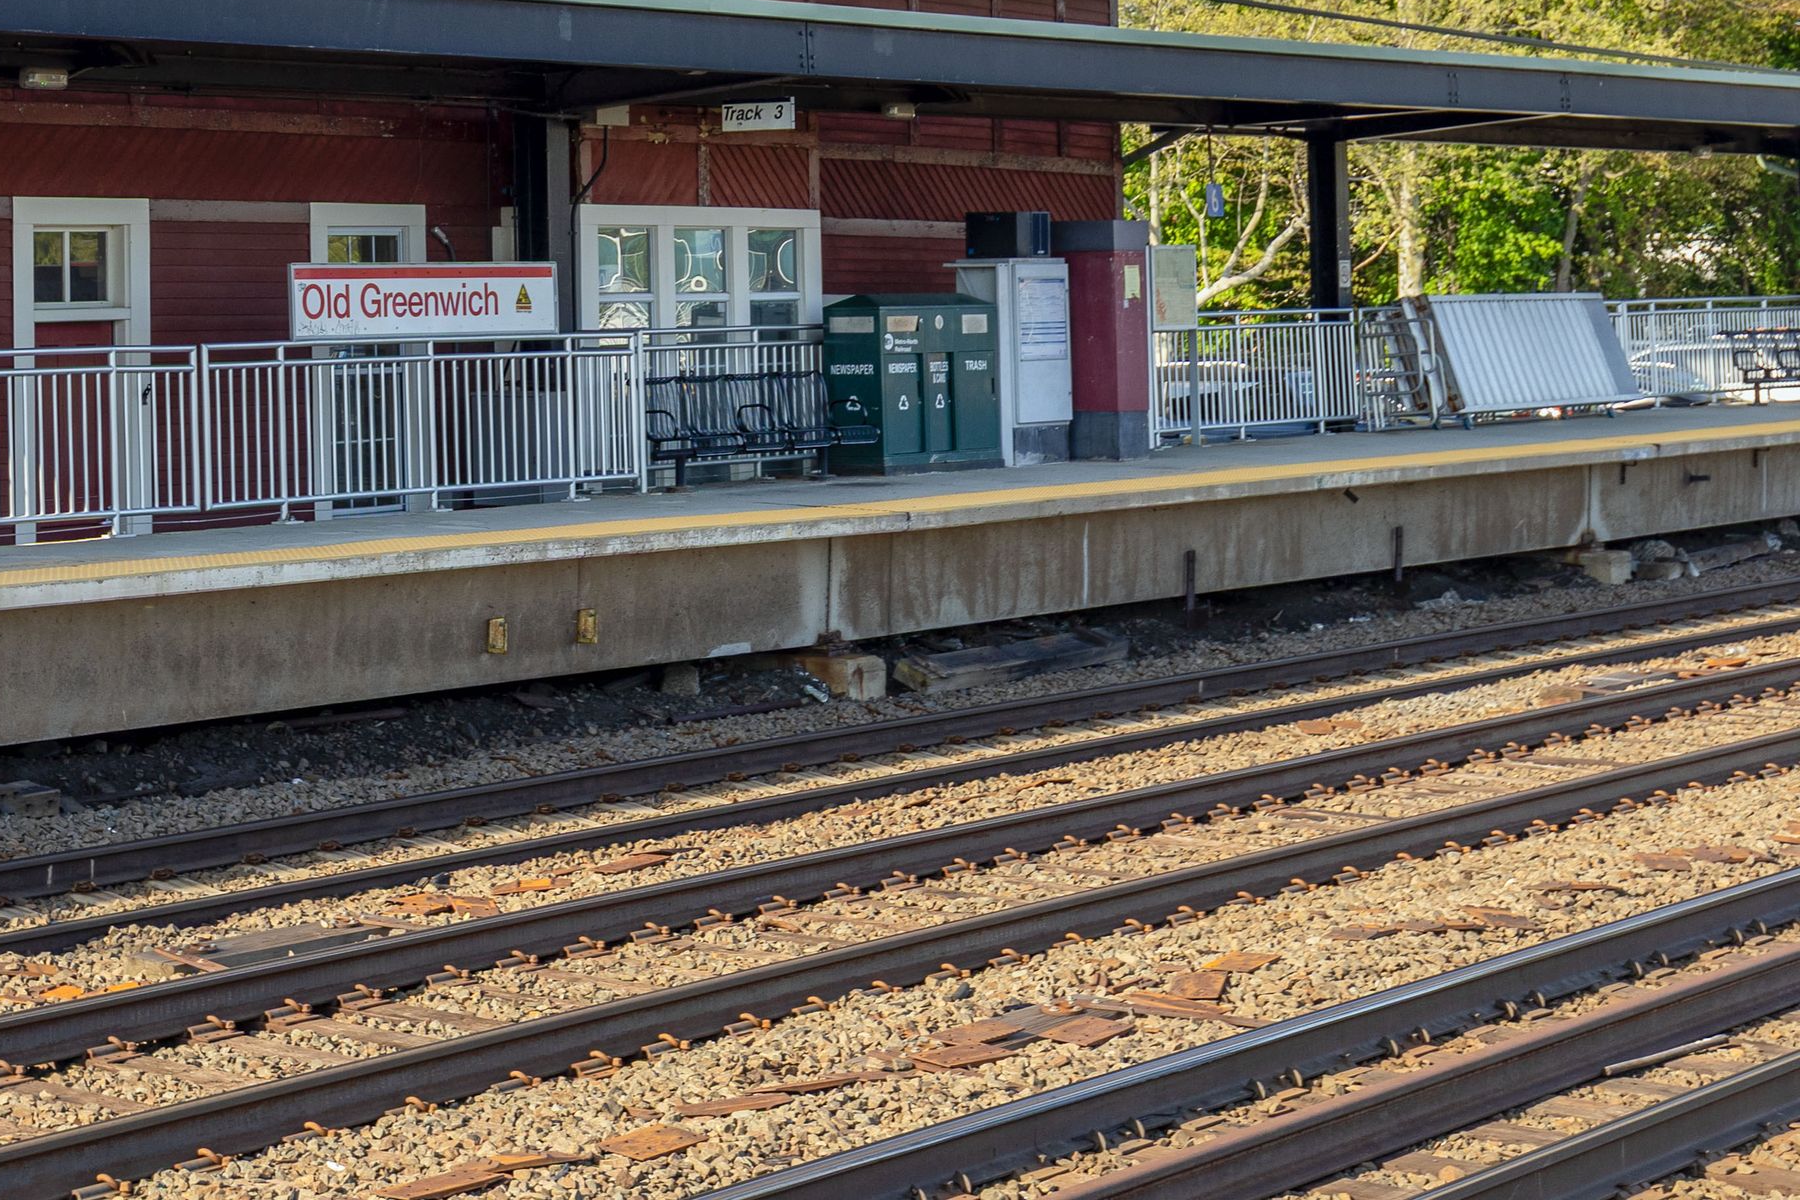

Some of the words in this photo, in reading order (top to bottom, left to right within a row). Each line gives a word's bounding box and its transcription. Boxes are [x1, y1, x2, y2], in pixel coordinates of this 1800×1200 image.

[724, 105, 763, 121] Track
[774, 104, 784, 119] 3
[302, 283, 350, 319] Old
[361, 282, 499, 318] Greenwich
[830, 364, 874, 375] NEWSPAPER
[888, 362, 918, 374] NEWSPAPER
[964, 360, 987, 371] TRASH
